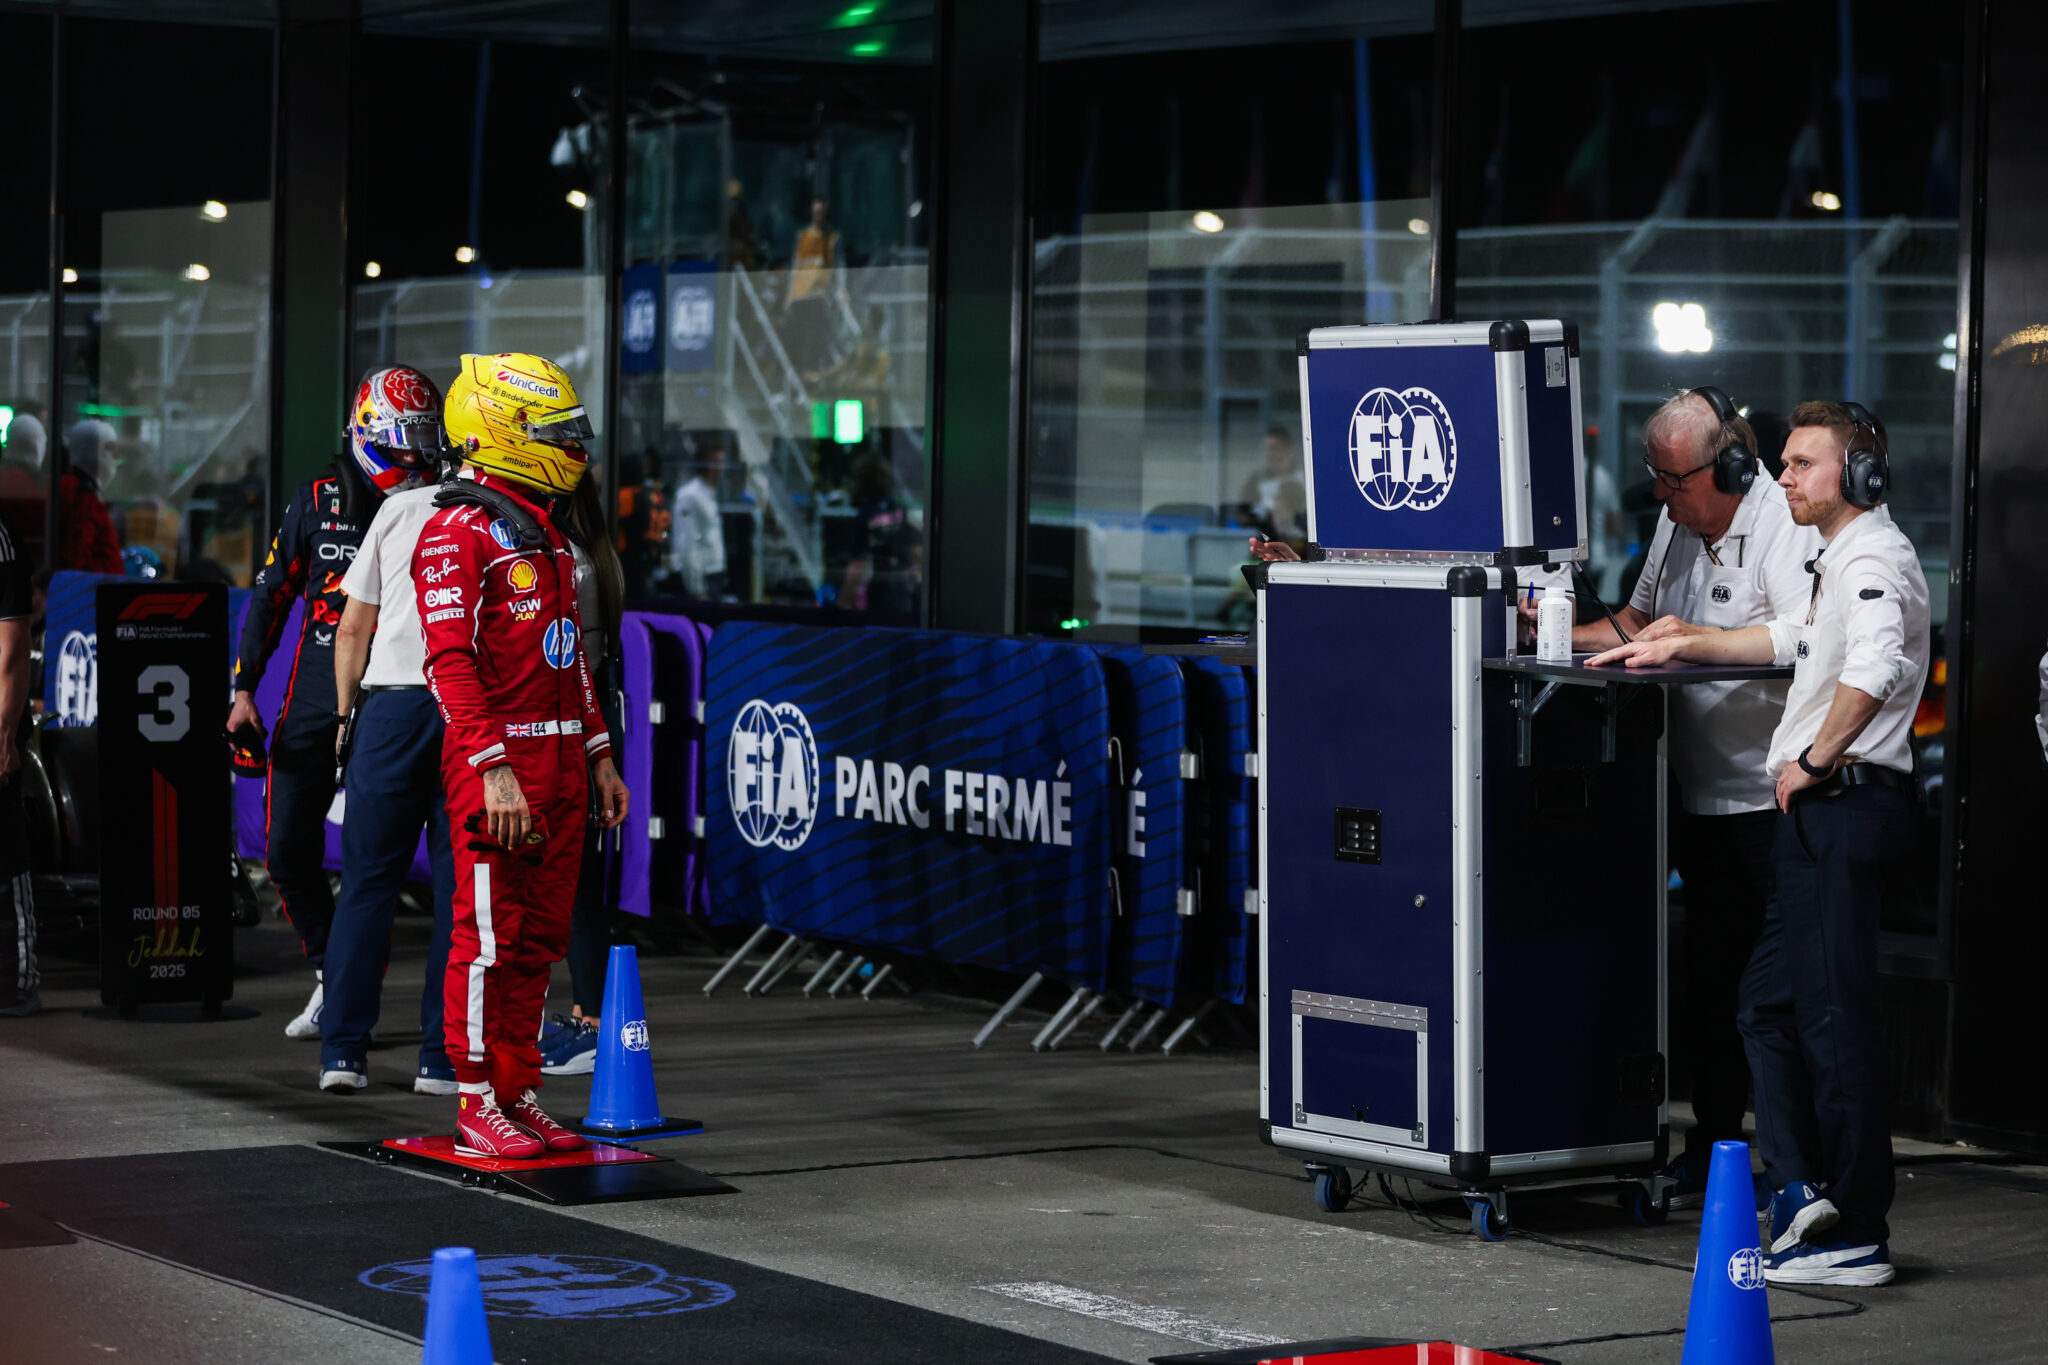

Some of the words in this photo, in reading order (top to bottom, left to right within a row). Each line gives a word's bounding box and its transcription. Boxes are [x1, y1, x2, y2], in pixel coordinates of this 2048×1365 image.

[510, 375, 559, 398] UniCredit
[500, 391, 543, 408] Bitdefender
[397, 416, 441, 425] ORACL
[502, 455, 533, 469] ambipar
[320, 521, 349, 531] Mobil
[497, 525, 519, 545] hp
[425, 544, 459, 557] GENESYS
[508, 598, 541, 614] VGW
[427, 608, 465, 624] PIRELLI
[515, 611, 536, 621] PLAY
[548, 627, 574, 661] hp
[138, 665, 190, 742] 3
[533, 723, 546, 735] 44
[835, 755, 930, 827] PARC
[945, 759, 1072, 846] FERMÉ
[133, 907, 178, 920] ROUND
[182, 905, 200, 919] 05
[128, 927, 204, 968] Jeddah
[150, 964, 186, 978] 2025
